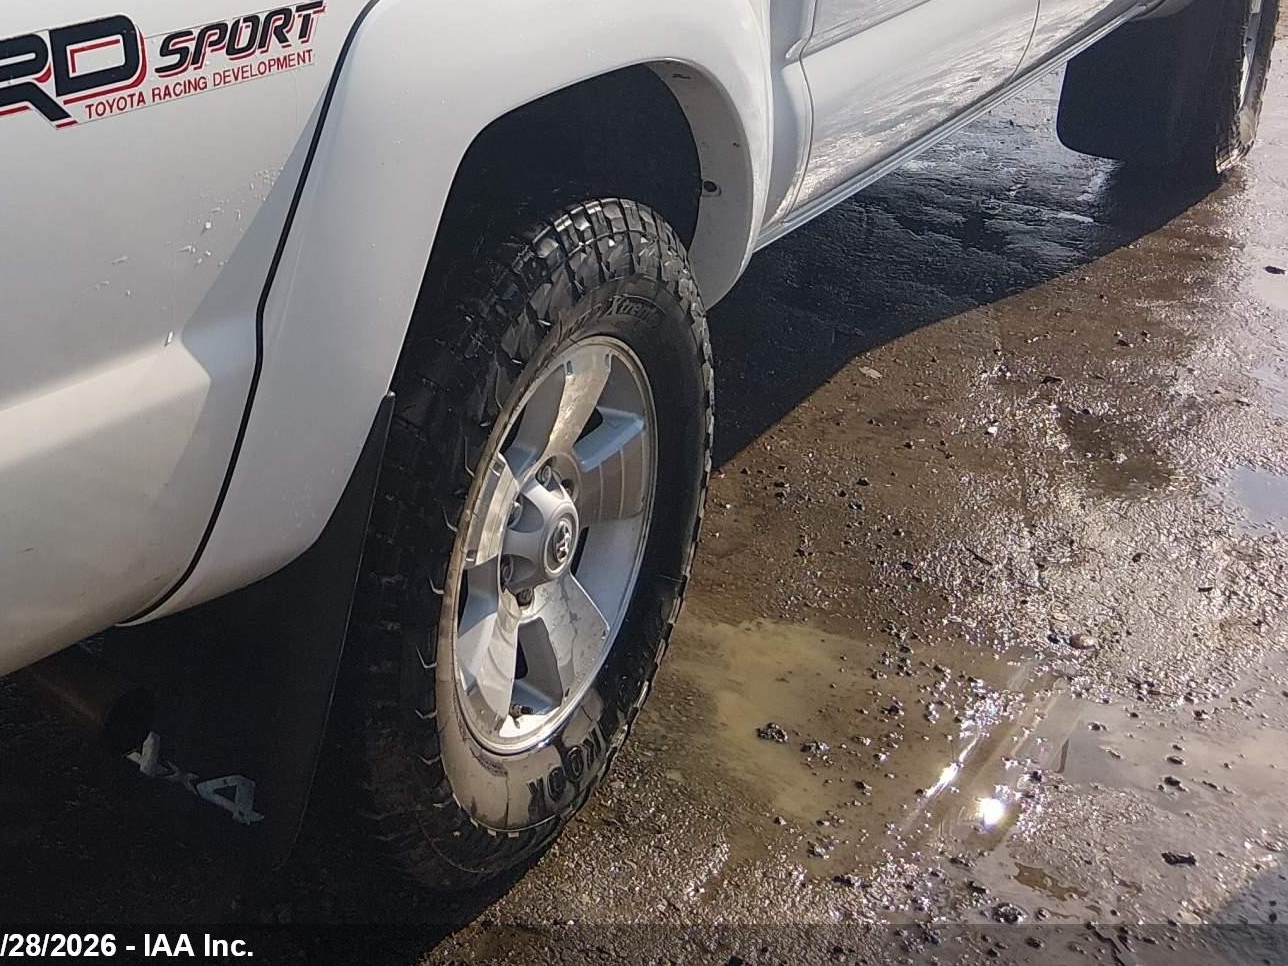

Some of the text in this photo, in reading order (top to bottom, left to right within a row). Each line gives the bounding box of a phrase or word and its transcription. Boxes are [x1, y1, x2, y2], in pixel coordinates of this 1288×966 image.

[84, 48, 314, 120] TOYOTA RACING DEVELOPMENT
